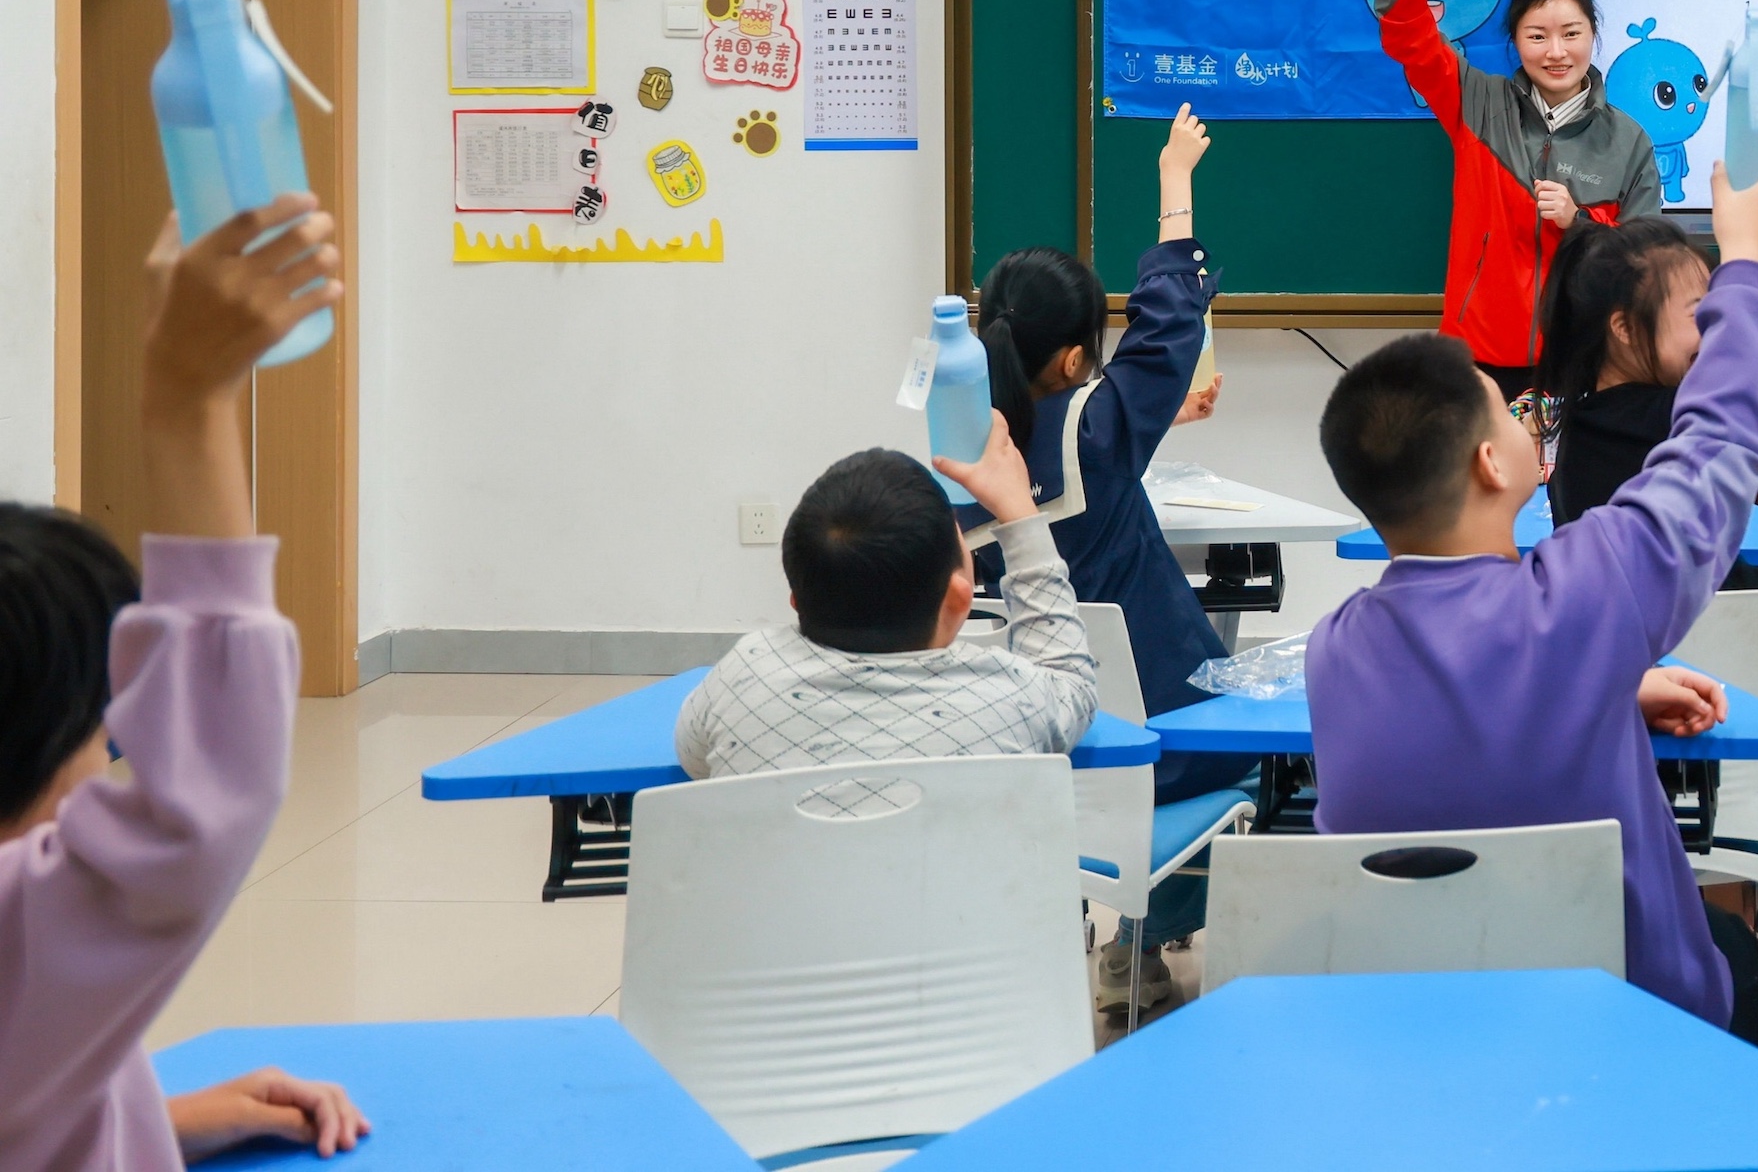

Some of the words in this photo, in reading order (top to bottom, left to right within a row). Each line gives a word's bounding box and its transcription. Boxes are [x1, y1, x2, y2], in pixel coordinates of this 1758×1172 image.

[714, 36, 791, 62] 祖国母亲
[713, 54, 788, 79] 生日快乐
[1154, 53, 1218, 75] 壹基金
[1154, 76, 1171, 85] One
[1172, 76, 1218, 86] Foundation
